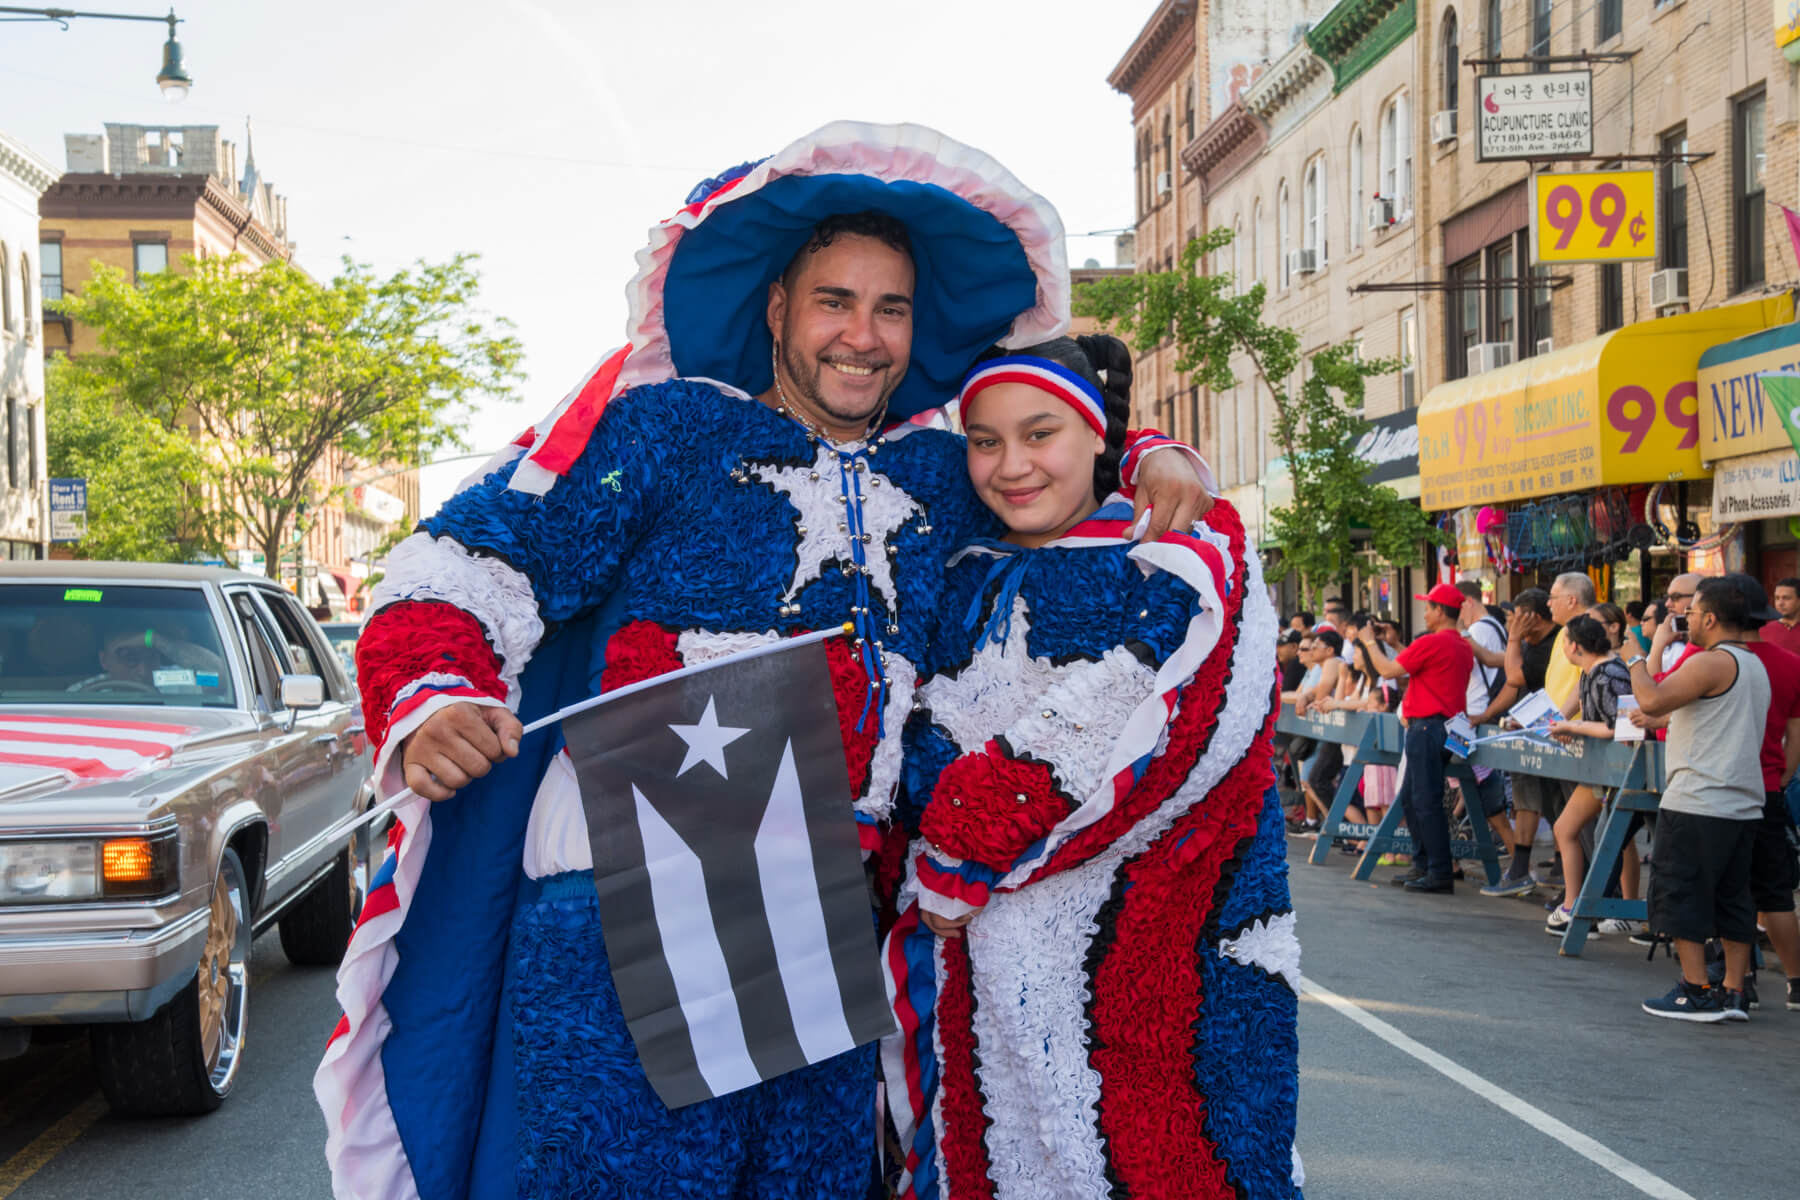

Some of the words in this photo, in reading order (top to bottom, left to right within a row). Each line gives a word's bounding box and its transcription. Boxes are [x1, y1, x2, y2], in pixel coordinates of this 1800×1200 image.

[1544, 81, 1585, 98] 한의원
[1484, 113, 1553, 132] ACUPUNCTURE
[1557, 111, 1589, 128] CLINIC
[1514, 397, 1558, 434] DISCOUNT
[1561, 389, 1591, 424] INC.
[1710, 370, 1767, 443] NEW
[1751, 490, 1791, 510] Accessories
[1520, 753, 1542, 769] NYPD
[1338, 823, 1378, 837] POLIC
